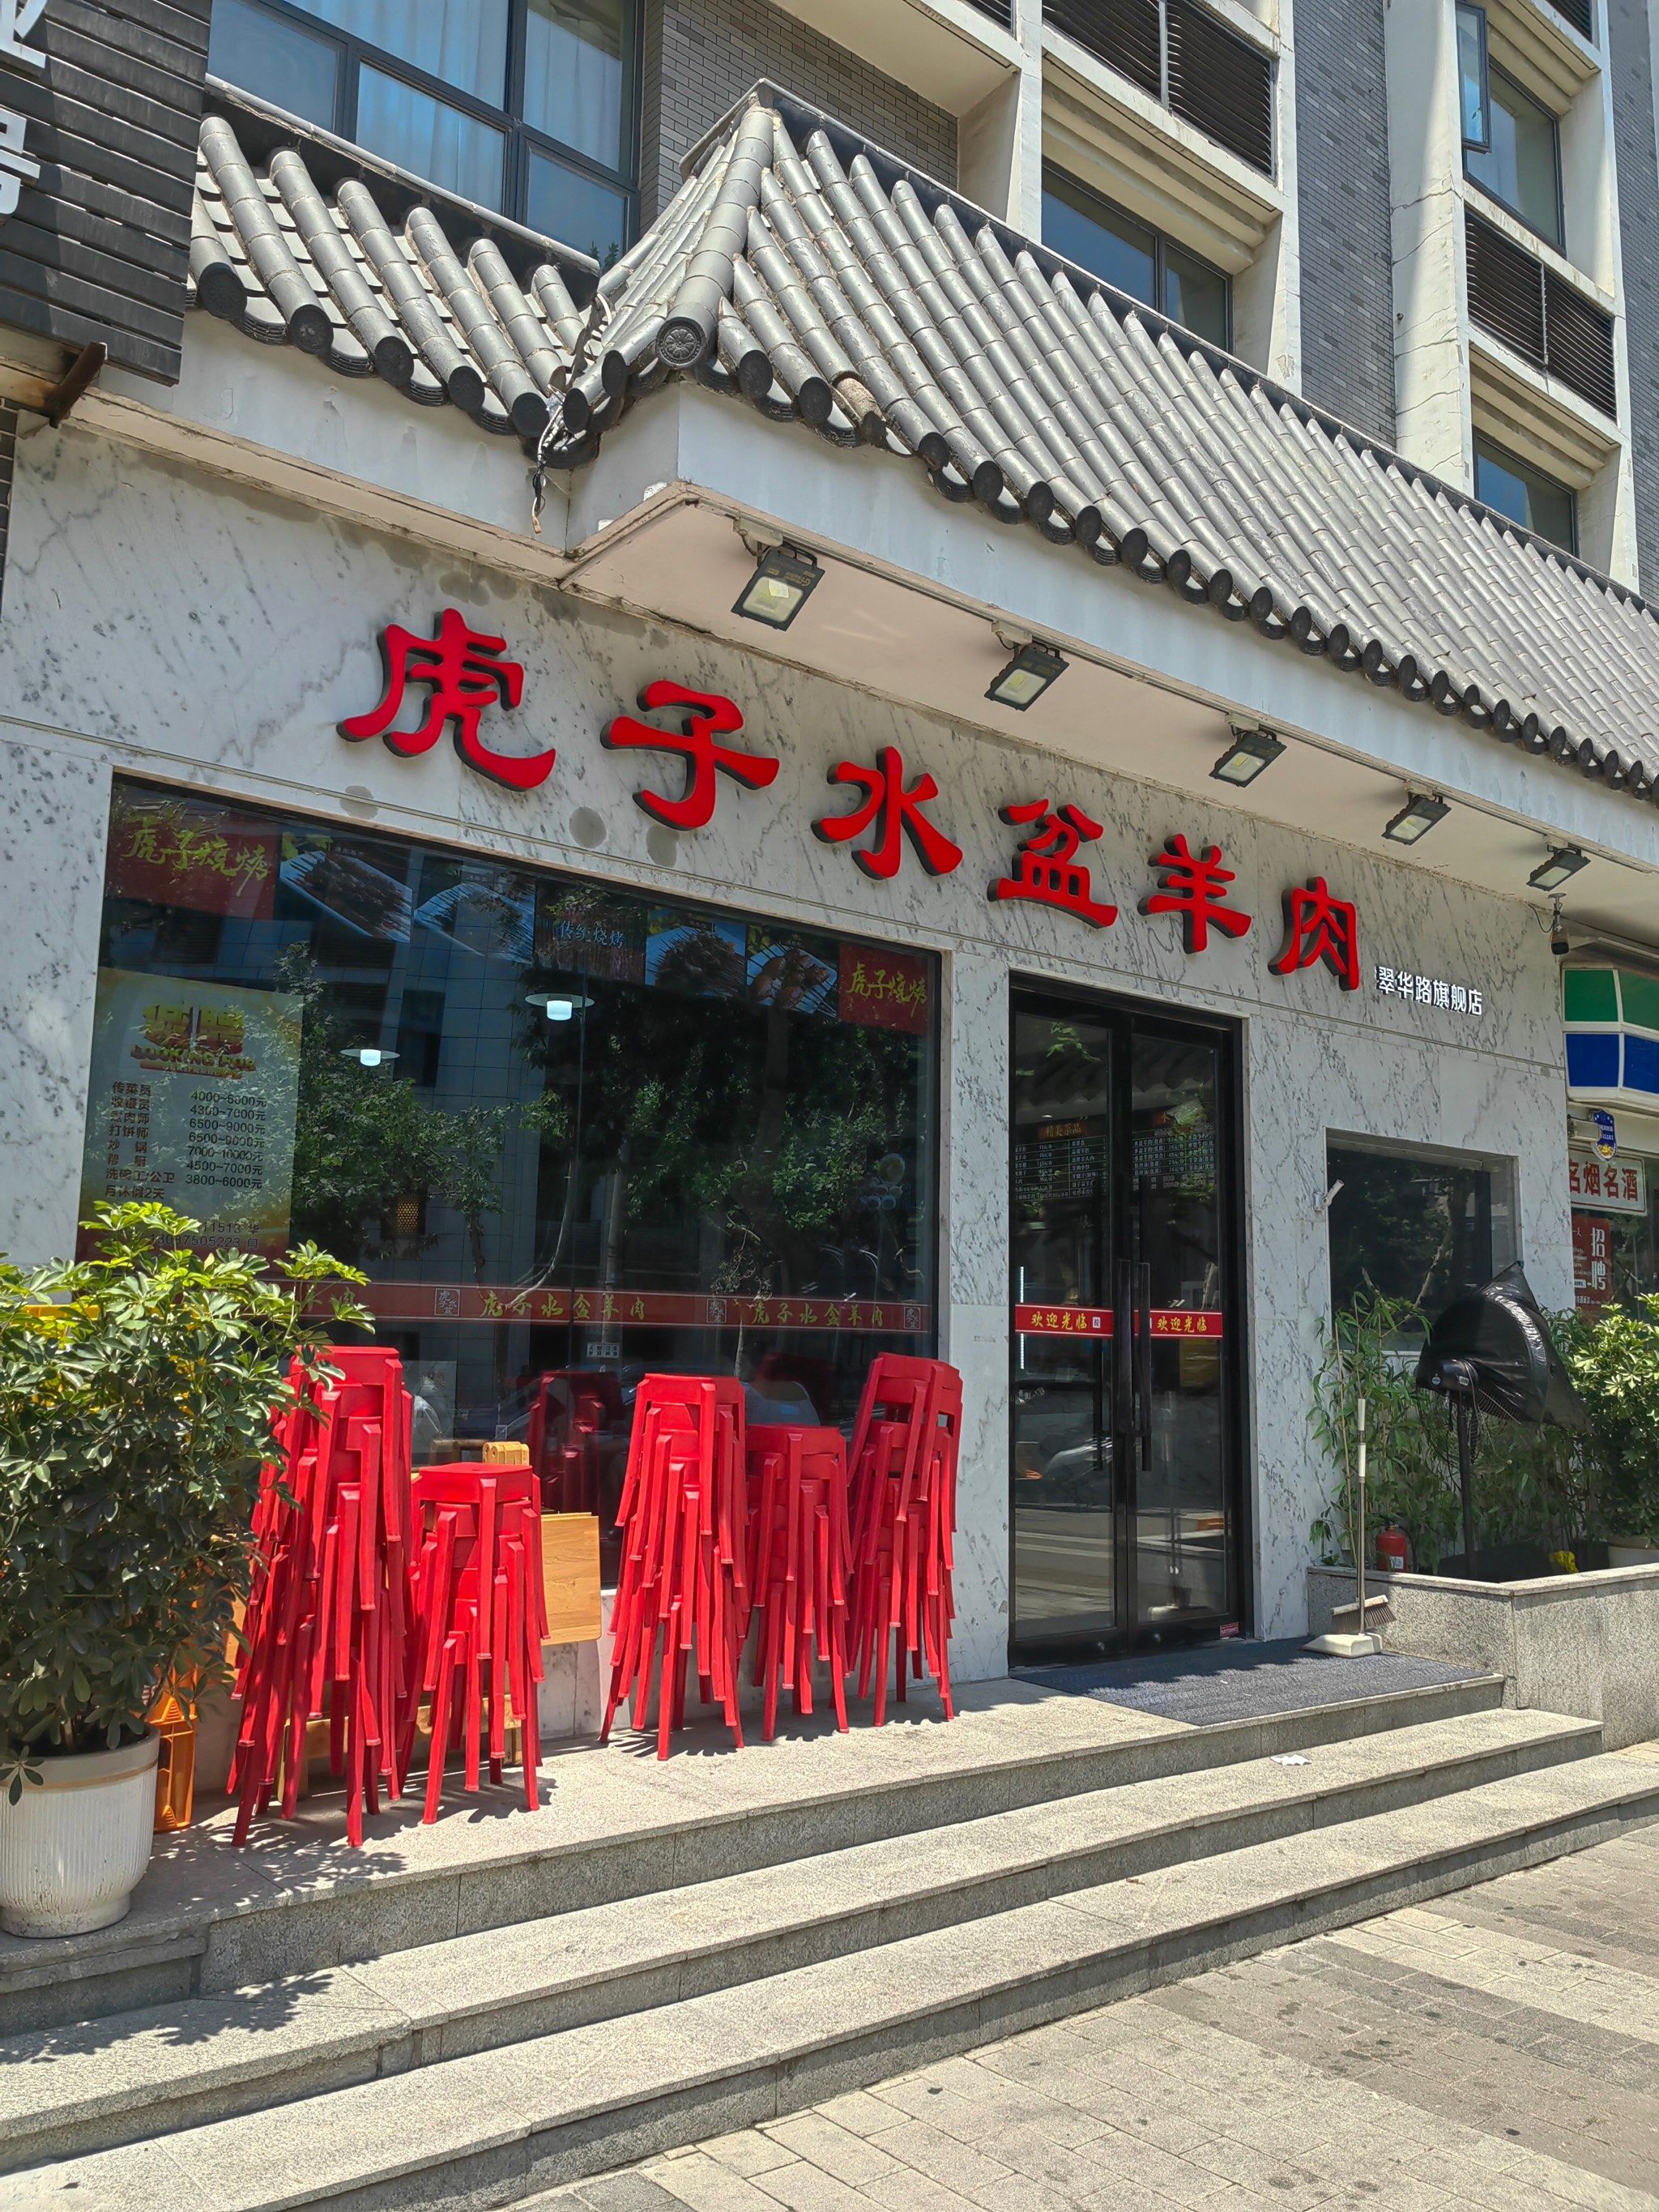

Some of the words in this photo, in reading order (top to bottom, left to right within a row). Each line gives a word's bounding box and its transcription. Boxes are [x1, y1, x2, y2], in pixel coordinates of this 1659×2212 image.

[337, 608, 1360, 991] 虎子水盆羊肉
[847, 961, 928, 1018] 虎子烧烤
[1378, 966, 1482, 1016] 翠华路旗舰店
[113, 1081, 151, 1096] 传菜员
[190, 1104, 266, 1121] 4300~7000元
[109, 1125, 149, 1139] 打饼师
[190, 1118, 265, 1134] 6500~9000元
[186, 1159, 262, 1175] 4500~7000元
[186, 1174, 262, 1189] 3800~6000元
[1569, 1158, 1638, 1201] 名烟名酒
[104, 1185, 165, 1199] 月休假2天
[1590, 1227, 1606, 1291] 招聘
[480, 1290, 646, 1320] 虎子水盆羊肉
[752, 1300, 884, 1327] 虎子水盆羊肉
[1030, 1311, 1088, 1330] 欢迎光临
[1157, 1315, 1207, 1333] 欢迎光临
